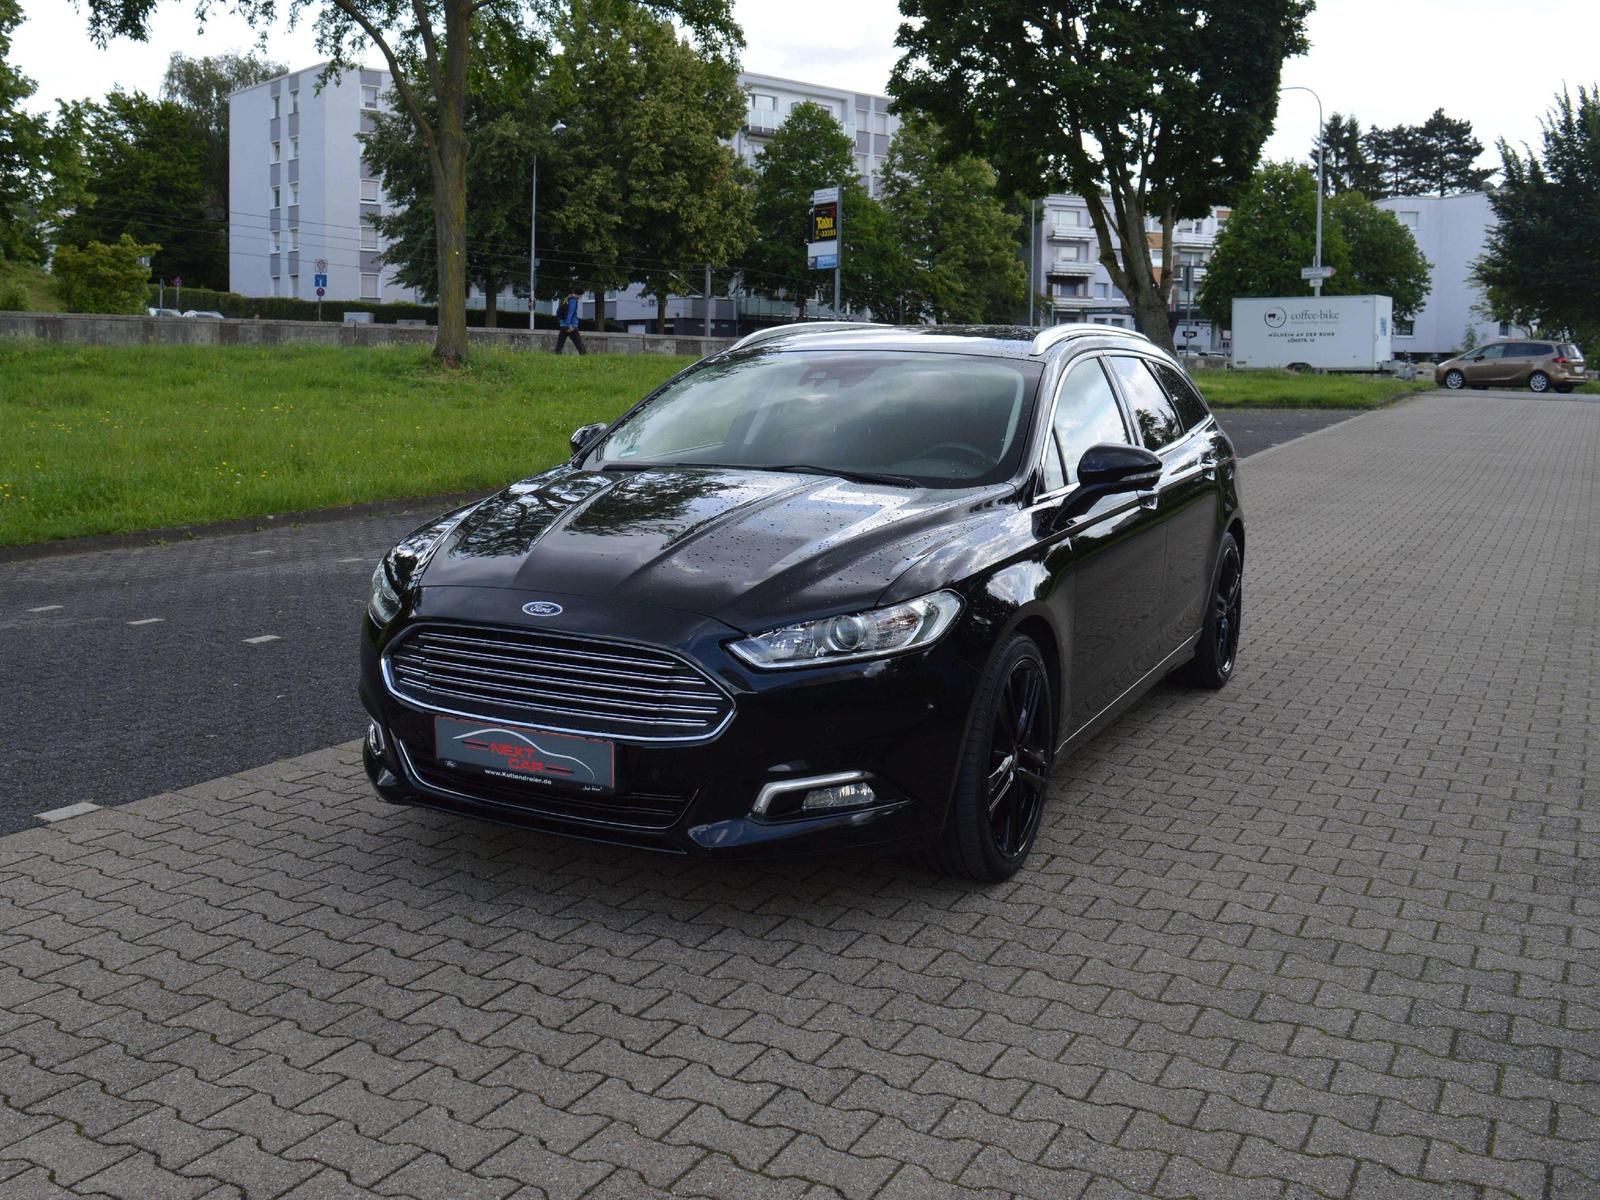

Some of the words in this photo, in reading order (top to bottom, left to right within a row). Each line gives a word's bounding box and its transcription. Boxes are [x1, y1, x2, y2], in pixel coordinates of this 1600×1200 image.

[1290, 310, 1339, 320] coffee-bike
[529, 603, 554, 613] Ford
[490, 741, 537, 758] NEXT
[508, 757, 545, 772] CAR
